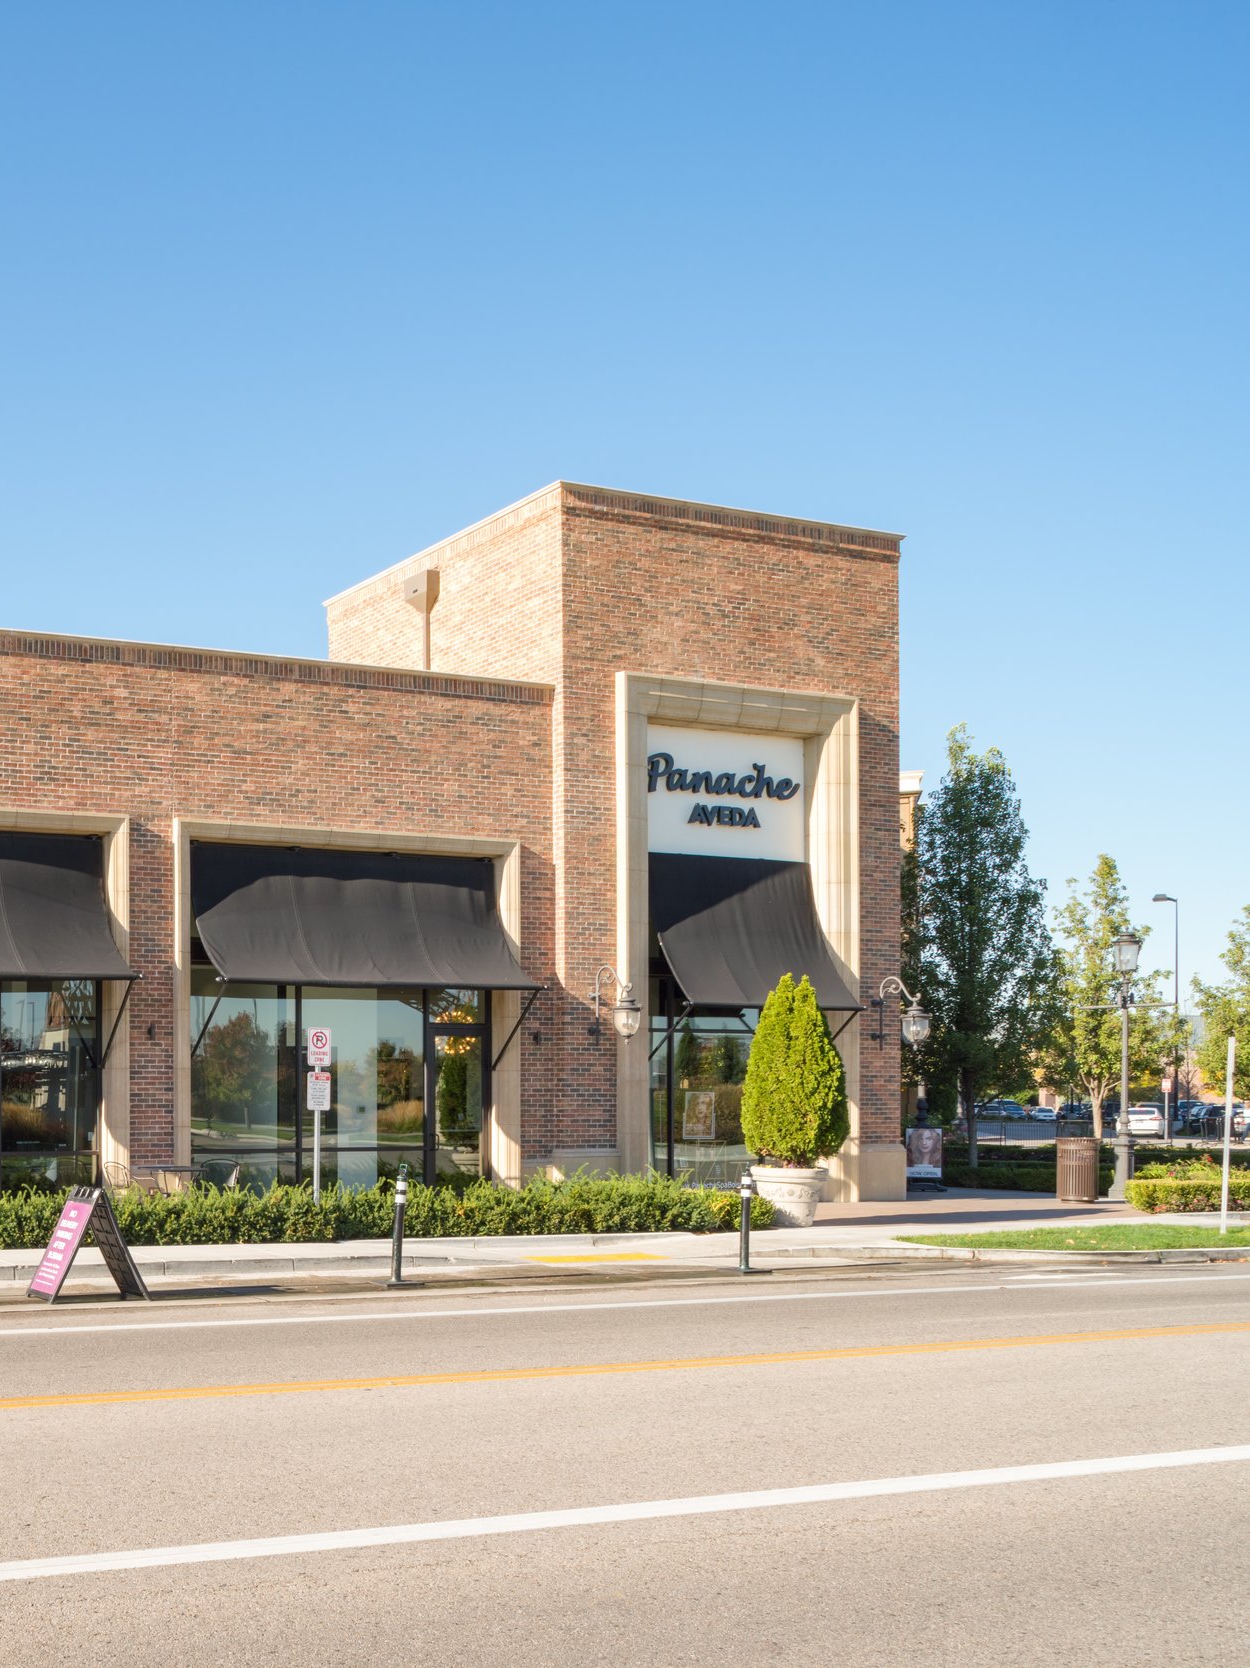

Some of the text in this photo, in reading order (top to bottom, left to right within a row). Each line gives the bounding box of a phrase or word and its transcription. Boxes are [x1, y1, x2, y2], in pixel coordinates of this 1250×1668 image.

[648, 752, 800, 800] Panache
[687, 802, 761, 828] AVEDA
[69, 1209, 78, 1218] NO
